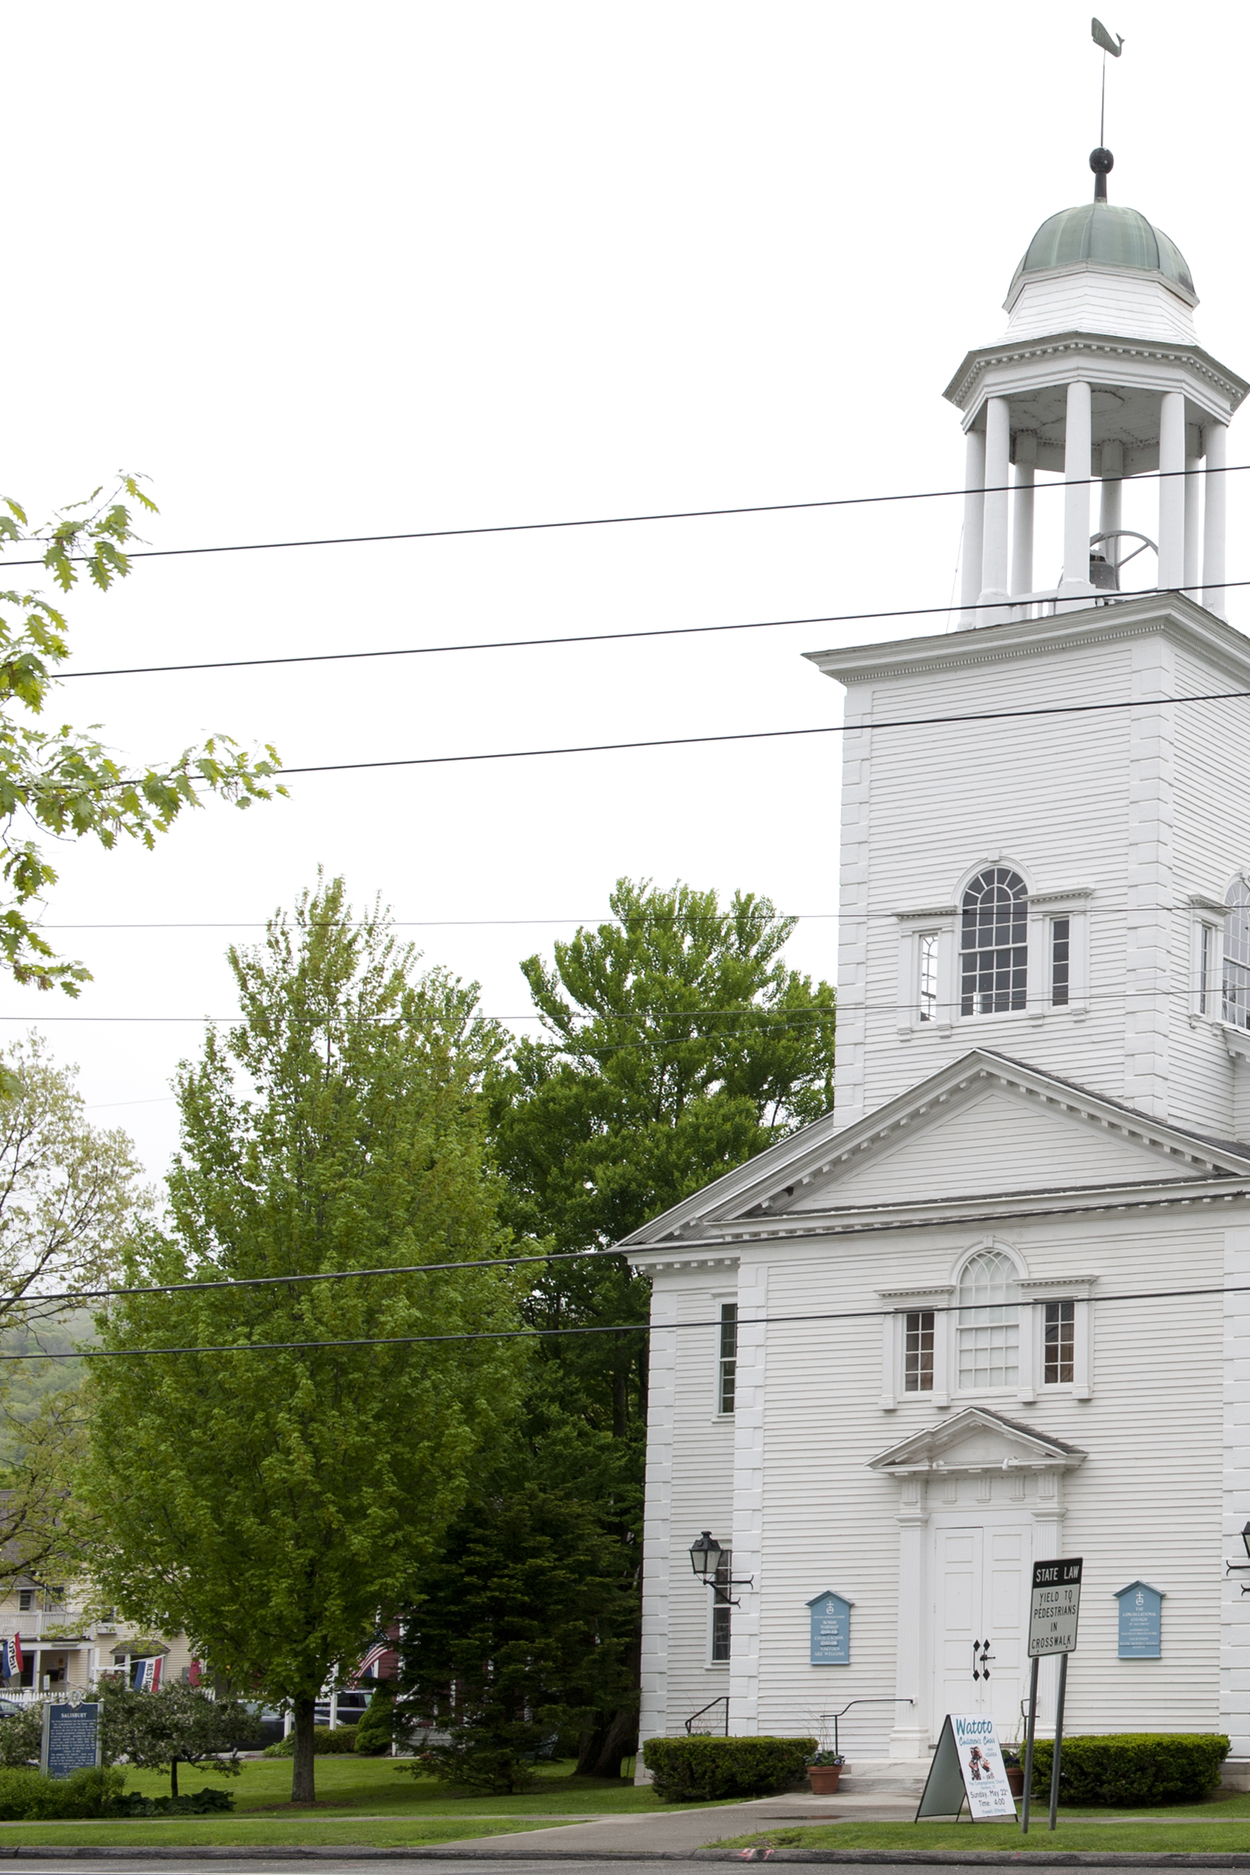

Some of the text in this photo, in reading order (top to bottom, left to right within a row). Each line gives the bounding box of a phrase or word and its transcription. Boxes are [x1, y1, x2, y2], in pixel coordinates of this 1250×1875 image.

[1036, 1565, 1080, 1582] STATE LAW
[1039, 1589, 1073, 1604] YIELD TO
[1033, 1604, 1076, 1619] PEDESTRIANS
[1050, 1622, 1058, 1632] IN
[1031, 1634, 1072, 1649] CROSSWALK
[955, 1717, 993, 1736] Watoto
[989, 1789, 1000, 1798] May
